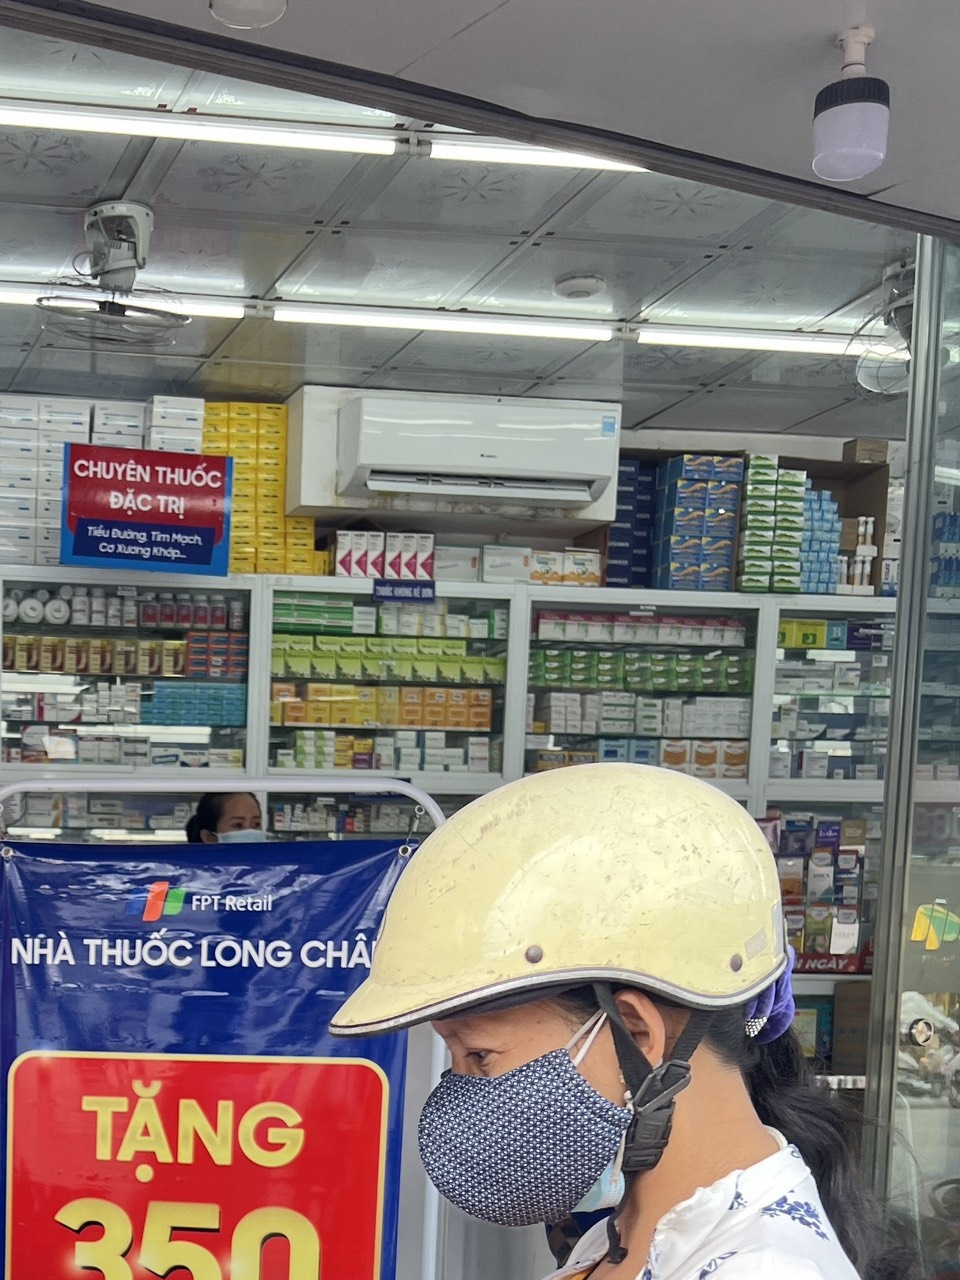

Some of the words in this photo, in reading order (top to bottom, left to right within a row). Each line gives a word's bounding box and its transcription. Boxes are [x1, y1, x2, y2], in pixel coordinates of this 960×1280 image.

[74, 460, 150, 483] CHUYÊN
[155, 463, 222, 488] THUỐC
[109, 488, 153, 516] ĐẶC
[157, 495, 185, 520] TRỊ
[87, 525, 110, 538] Tiểu
[150, 531, 170, 542] Tim
[99, 542, 115, 553] Cơ
[116, 544, 150, 558] Xương
[191, 895, 222, 913] FPT
[226, 894, 273, 913] Retail
[11, 930, 75, 966] NHÀ
[83, 927, 192, 967] THUỐC
[200, 939, 292, 968] LONG
[300, 932, 378, 968] CHÂ
[81, 1080, 304, 1182] TẶNG
